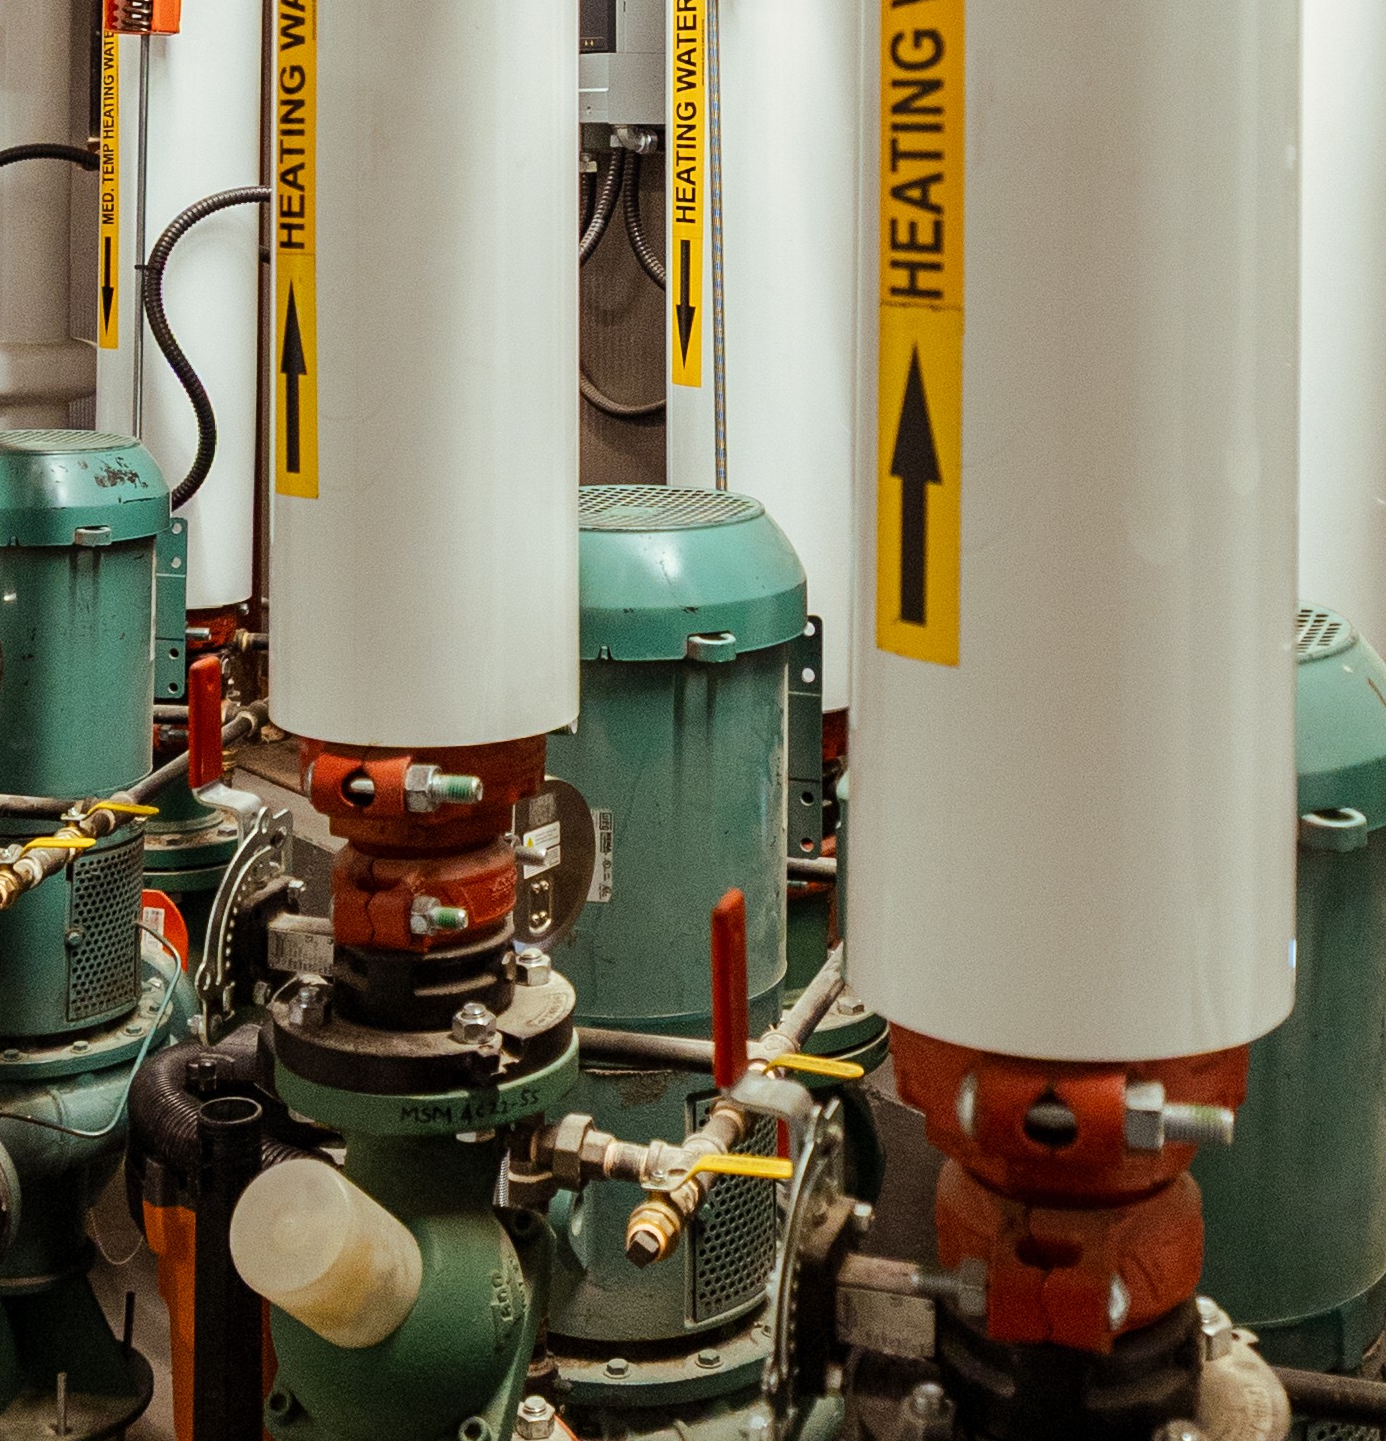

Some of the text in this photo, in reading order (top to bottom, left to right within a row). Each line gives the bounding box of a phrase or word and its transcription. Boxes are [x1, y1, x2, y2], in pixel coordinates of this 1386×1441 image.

[102, 32, 114, 225] MED. TEMP HEATING WATE
[278, 63, 307, 251] HEATING
[675, 102, 697, 224] HEATING
[890, 28, 946, 300] HEATING
